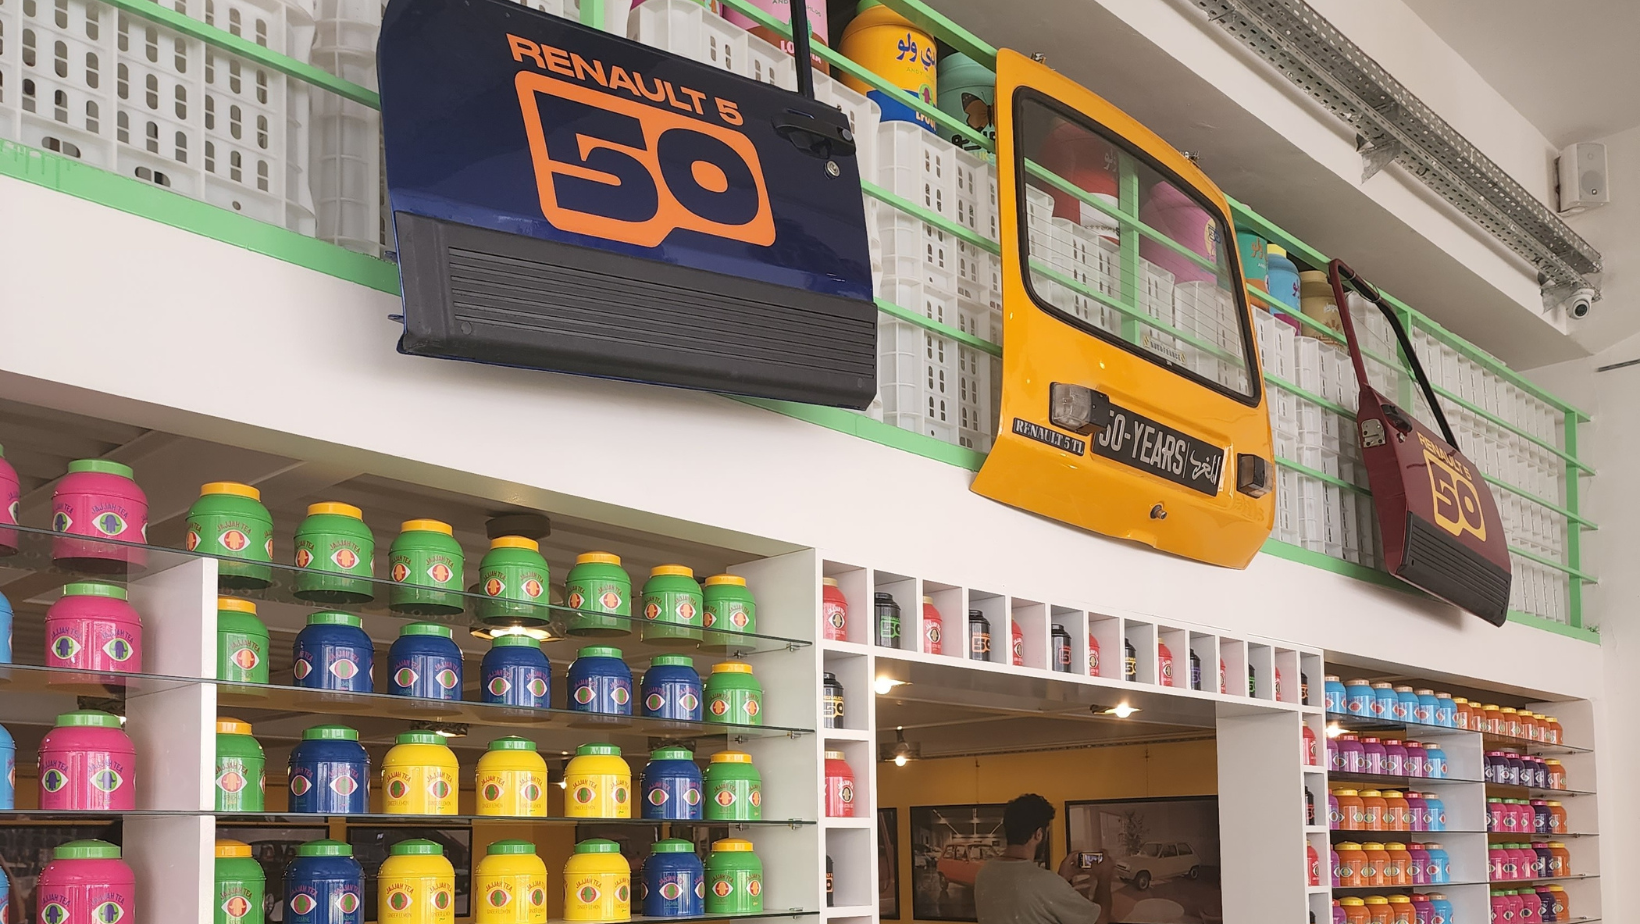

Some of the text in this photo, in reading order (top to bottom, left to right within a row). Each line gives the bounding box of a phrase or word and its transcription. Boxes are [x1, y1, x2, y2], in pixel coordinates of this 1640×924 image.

[506, 33, 745, 127] RENAULT 5
[528, 85, 765, 232] 50
[1015, 419, 1084, 454] RENAULT 5 TL
[1416, 431, 1472, 481] RENAULT 5
[1426, 455, 1483, 533] 50
[64, 503, 74, 514] TEA
[91, 503, 116, 514] JAJJAH
[117, 506, 128, 519] TEA
[193, 522, 202, 533] TEA
[217, 521, 240, 533] JAJJAH
[240, 523, 252, 535] TEA
[305, 541, 314, 551] TEA
[330, 540, 361, 553] JAJJAH TEA
[402, 556, 412, 565] TEA
[426, 554, 454, 568] JAJJAH TEA
[497, 571, 506, 580] TEA
[535, 572, 544, 584] TEA
[577, 585, 585, 594] TEA
[614, 586, 622, 596] TEA
[689, 596, 697, 607] TEA
[125, 631, 134, 643] TEA
[252, 642, 260, 653] TEA
[57, 761, 69, 773] TEA
[113, 761, 124, 773] TEA
[237, 764, 248, 775] TEA
[386, 772, 412, 783] JAJJAH TEA
[444, 772, 453, 783] TEA
[481, 776, 506, 787] JAJJAH TEA
[572, 779, 598, 790] JAJJAH TEA
[386, 883, 414, 895] JAJJAH TEA
[485, 880, 513, 892] JAJJAH TEA
[575, 878, 602, 889] JAJJAH TEA
[115, 894, 125, 906] TEA
[220, 887, 252, 901] JAJJAH TEA
[59, 897, 71, 909] TEA
